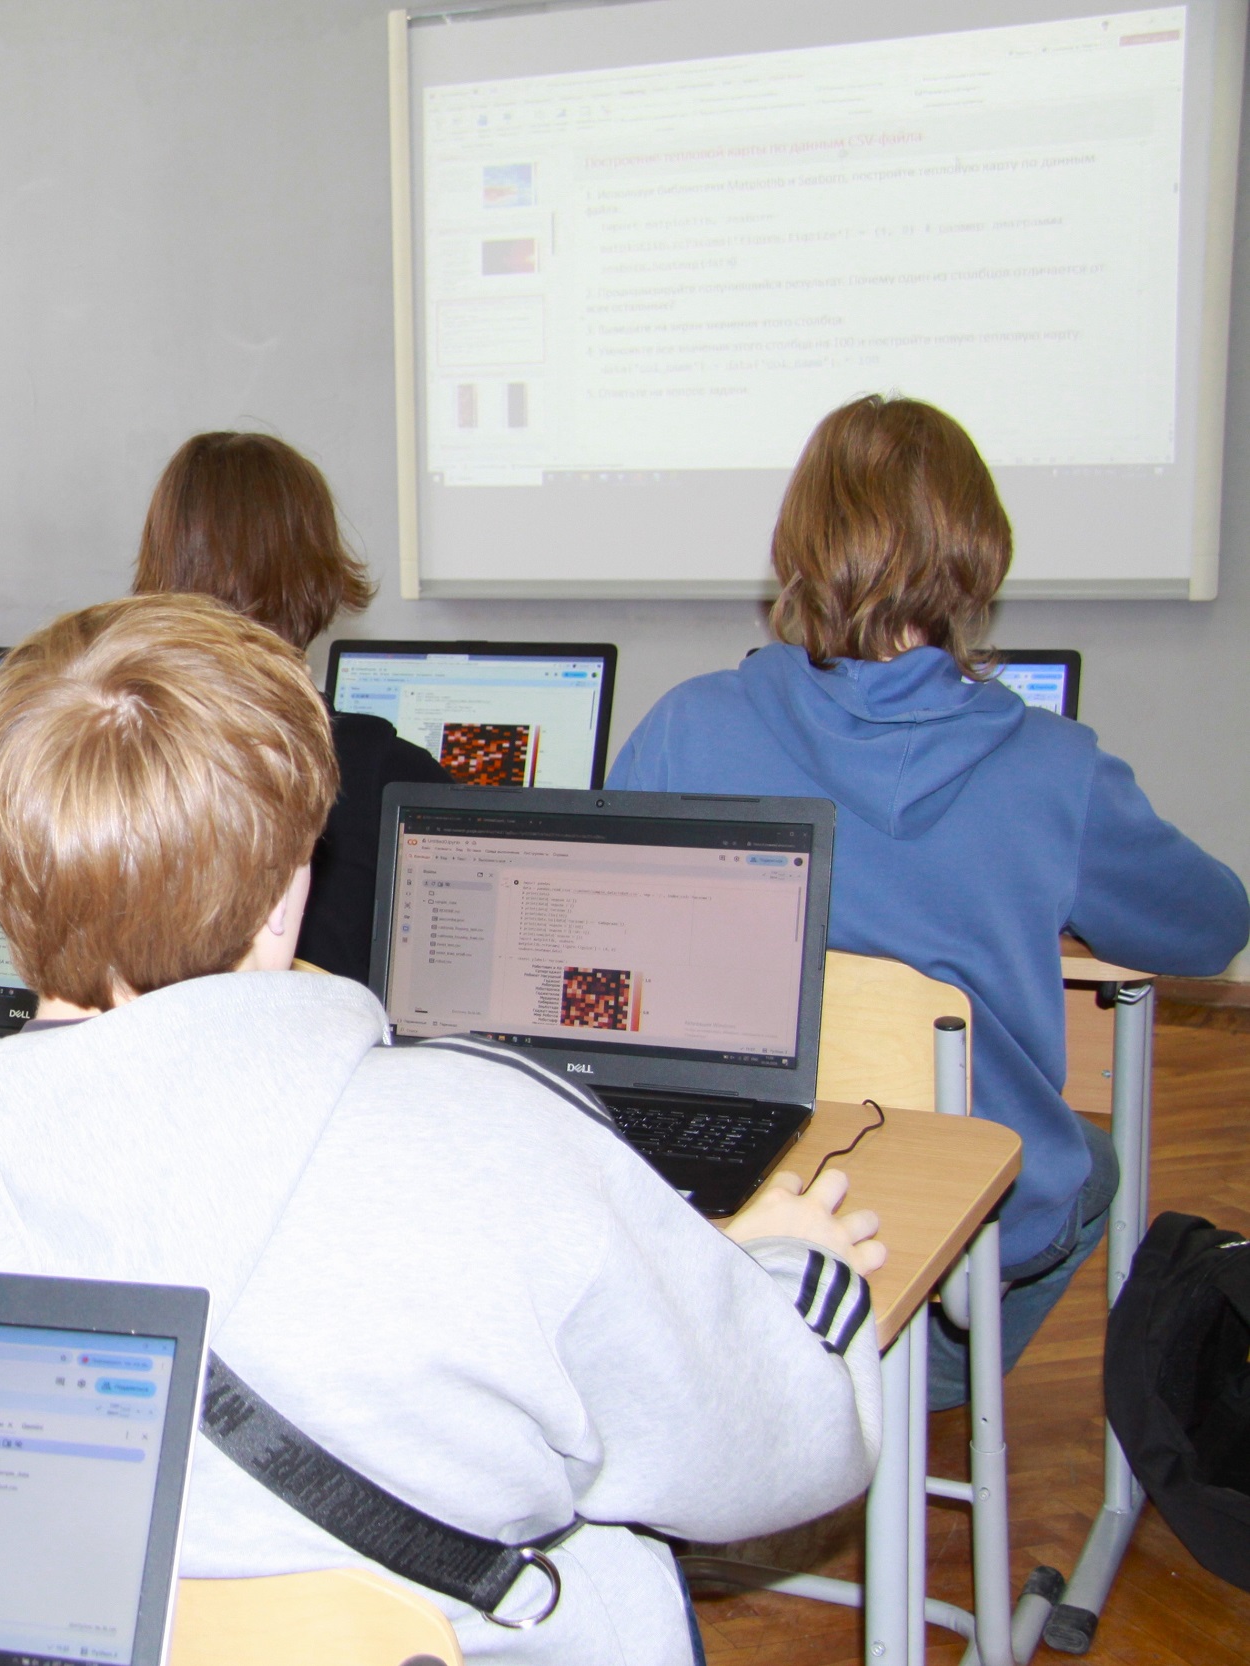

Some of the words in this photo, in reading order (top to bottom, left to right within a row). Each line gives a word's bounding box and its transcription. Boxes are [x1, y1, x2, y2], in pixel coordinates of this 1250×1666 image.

[664, 146, 724, 163] тепловой
[727, 143, 766, 158] карты
[789, 138, 845, 154] данным
[848, 131, 923, 148] CSV-файла
[852, 168, 915, 184] постройте
[982, 160, 1018, 173] карту
[1040, 154, 1096, 169] данным
[850, 274, 895, 286] Почему
[834, 336, 854, 348] 100
[9, 1009, 31, 1019] DELL
[567, 1062, 594, 1074] DELL
